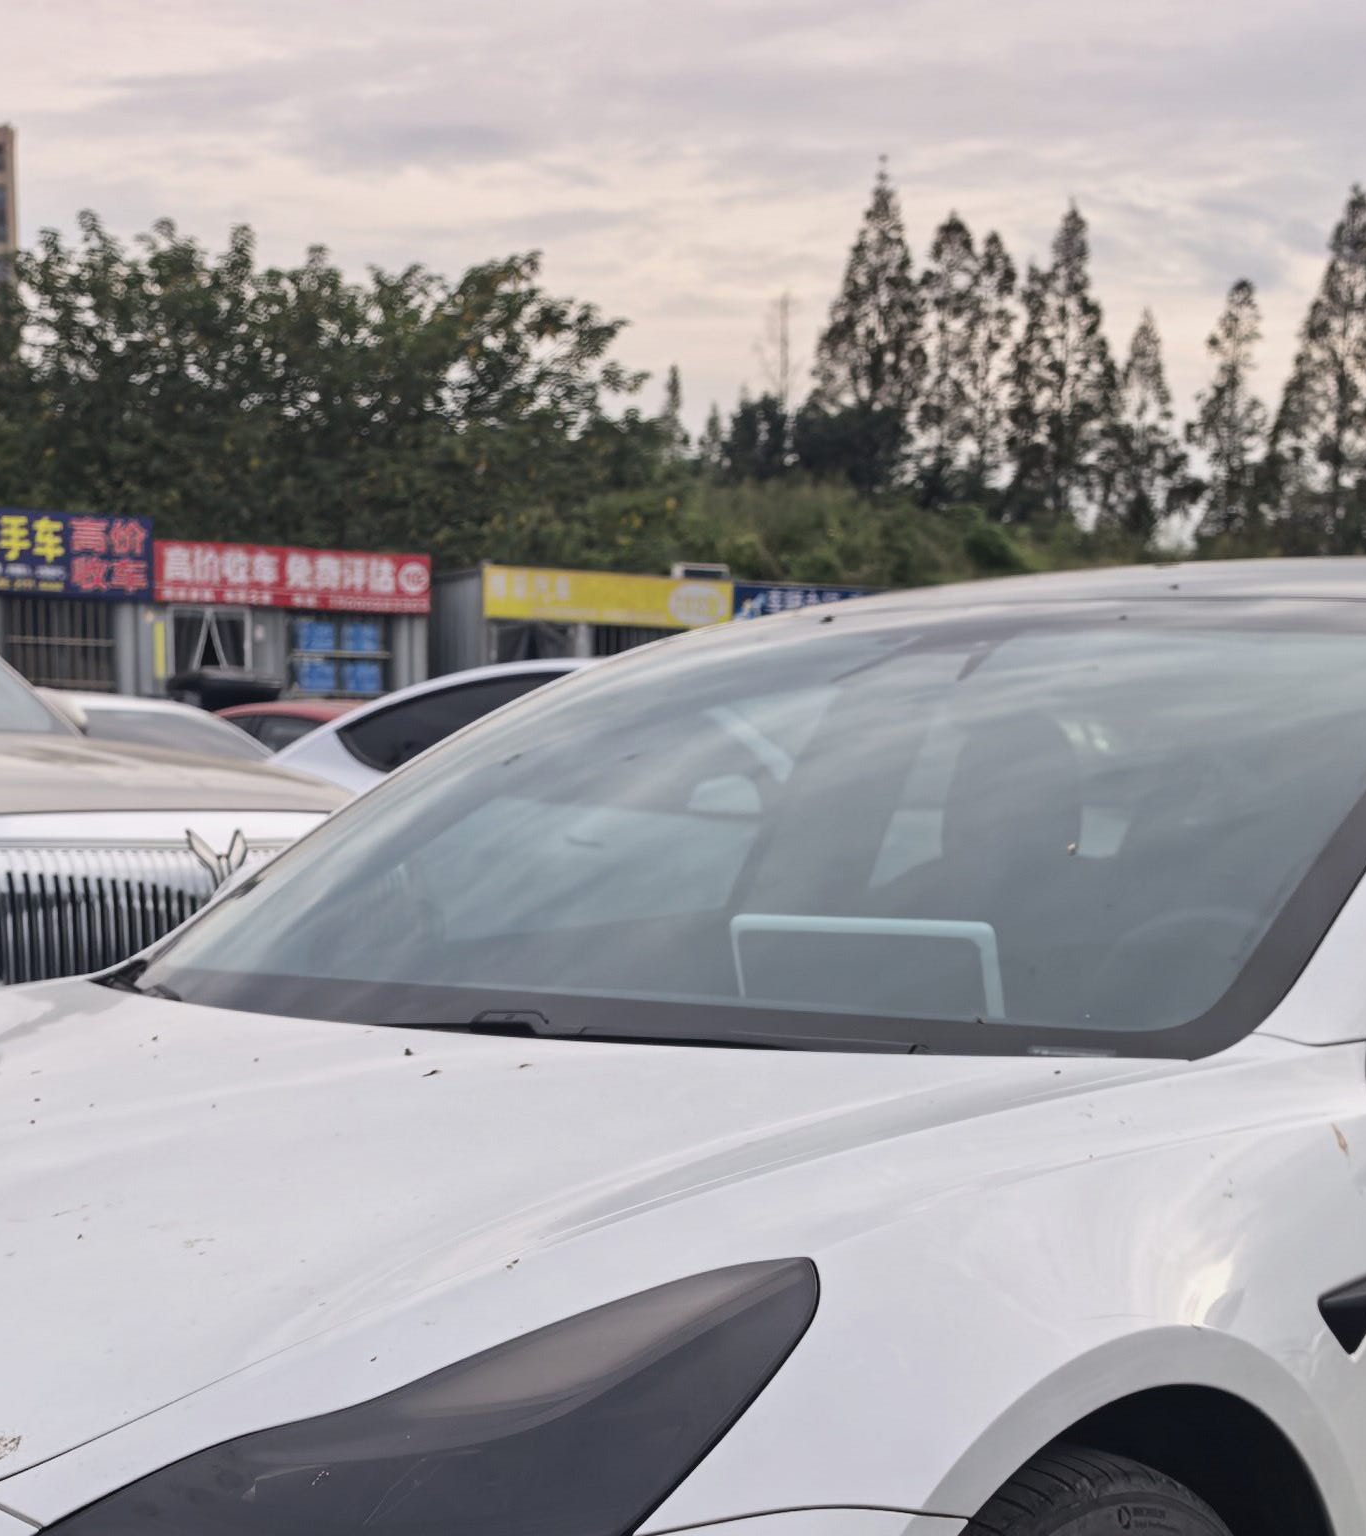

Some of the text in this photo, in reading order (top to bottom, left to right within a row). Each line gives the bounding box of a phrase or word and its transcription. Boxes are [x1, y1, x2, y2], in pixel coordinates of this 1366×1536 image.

[69, 516, 148, 554] 高价
[71, 556, 148, 592] 收车
[163, 547, 279, 584] 高价收车
